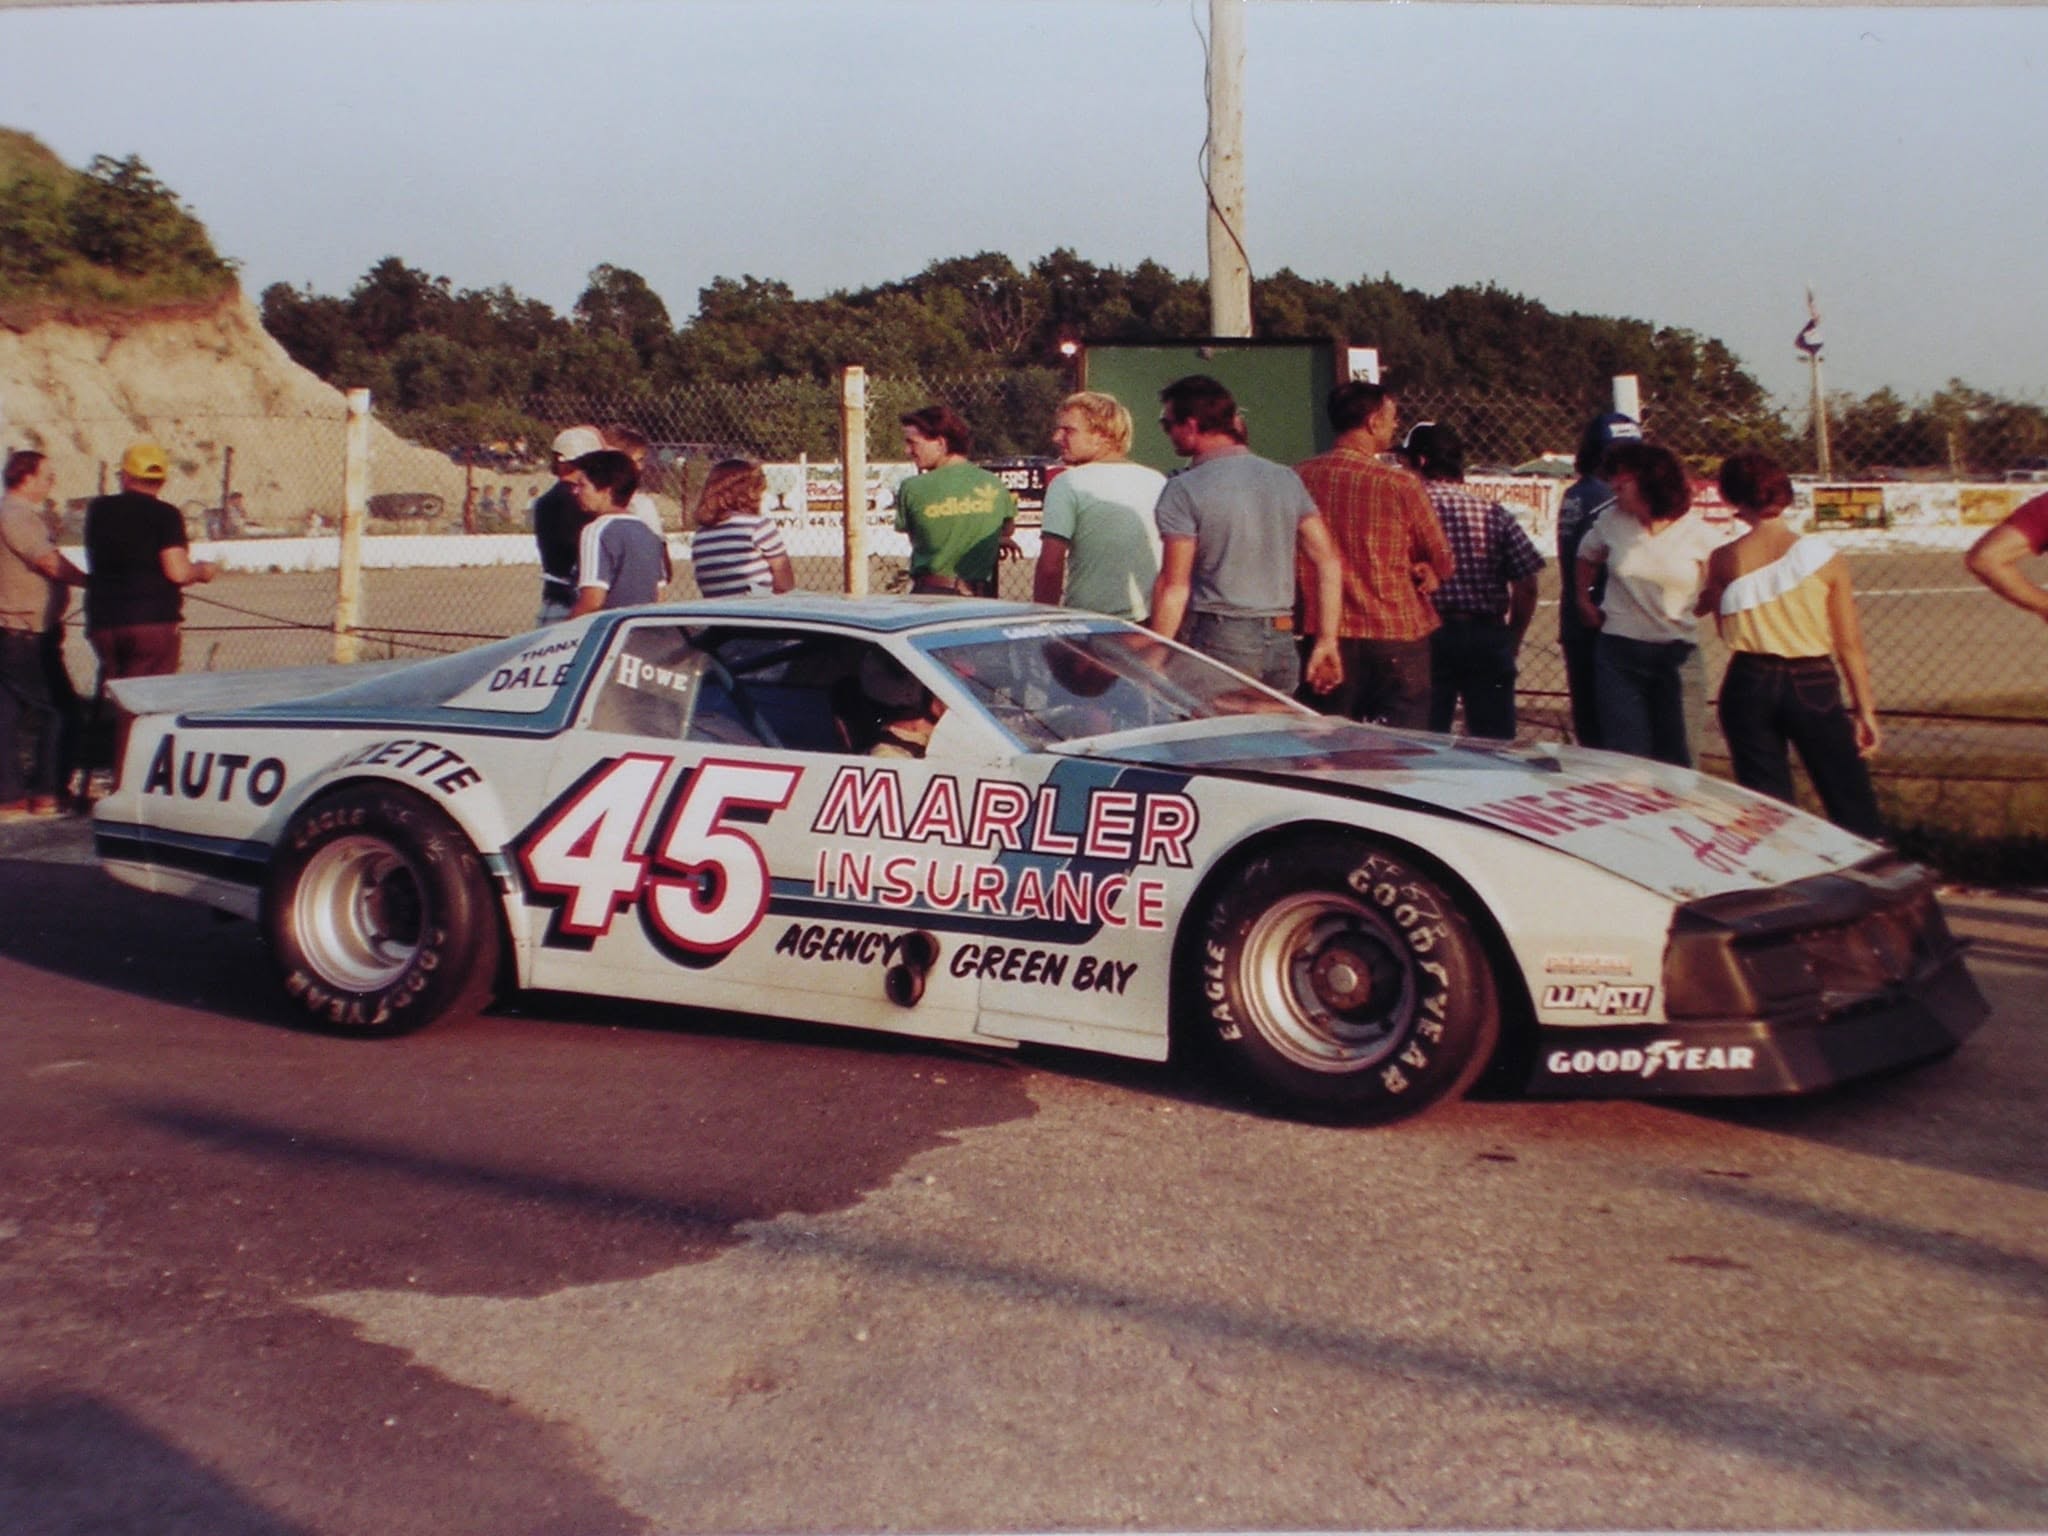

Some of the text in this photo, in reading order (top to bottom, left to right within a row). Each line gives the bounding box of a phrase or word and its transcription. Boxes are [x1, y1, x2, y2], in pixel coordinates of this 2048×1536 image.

[924, 497, 994, 518] adidas
[488, 662, 576, 692] DALE
[521, 638, 579, 662] THANX
[811, 765, 1201, 869] MARLER
[501, 751, 805, 970] 45
[812, 849, 1167, 931] INSURANCE
[775, 923, 1139, 997] AGENCY GREEN BAY
[1204, 939, 1243, 1041] EAGLE
[1347, 866, 1452, 1095] GOODYEAR
[1547, 1039, 1754, 1078] GOODYEAR
